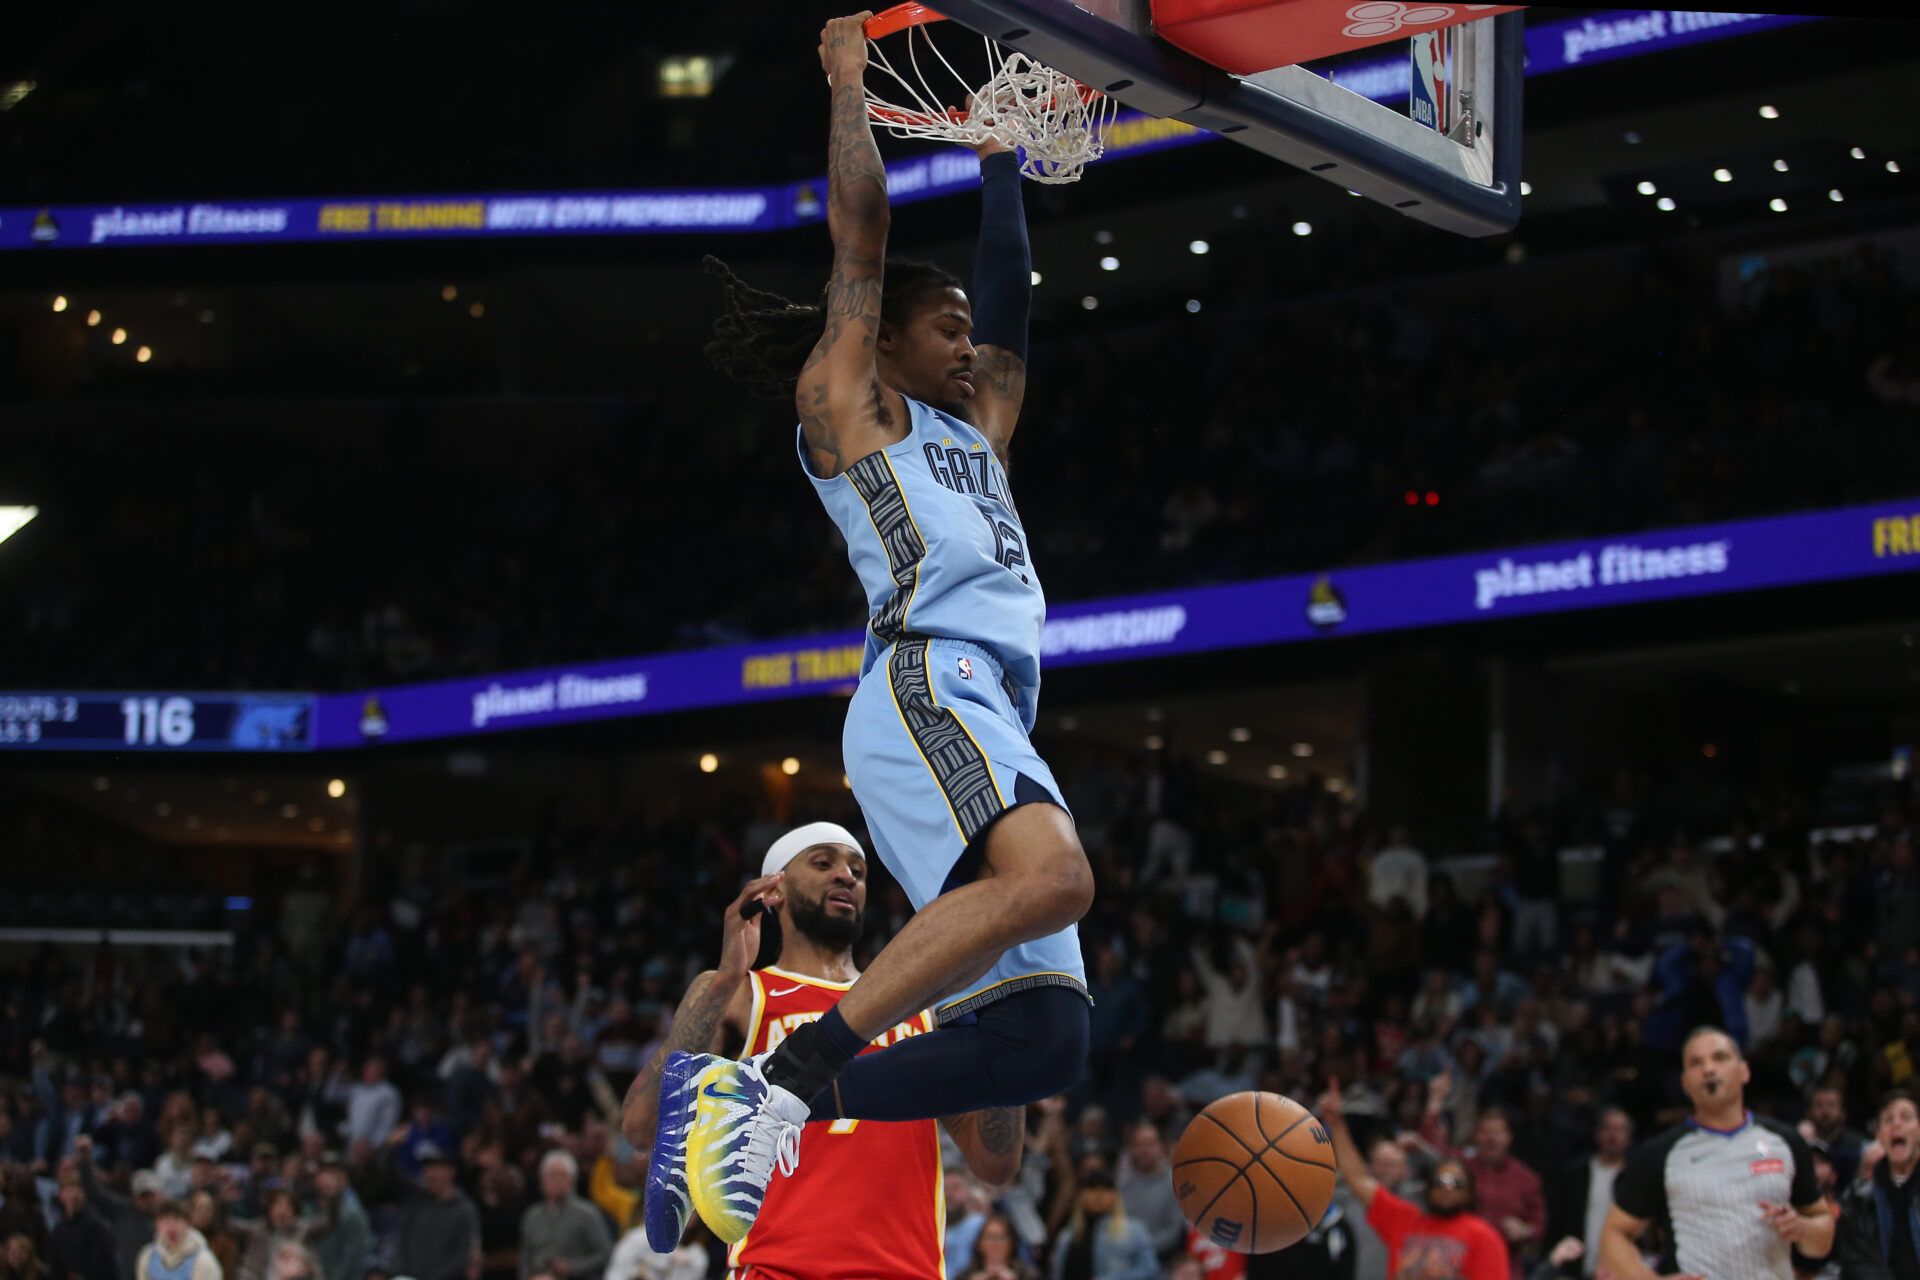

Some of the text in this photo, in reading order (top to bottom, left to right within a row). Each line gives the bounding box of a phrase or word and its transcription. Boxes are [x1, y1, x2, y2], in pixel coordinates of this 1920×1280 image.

[1563, 10, 1667, 64] planet
[1415, 97, 1433, 126] NBA
[90, 206, 184, 243] planet
[187, 204, 289, 234] fitness
[982, 511, 1028, 584] 12
[1474, 553, 1593, 609] planet
[1599, 540, 1730, 585] fitness
[472, 681, 554, 728] planet
[557, 672, 648, 710] fitness
[743, 652, 791, 688] FREE
[122, 697, 195, 746] 116
